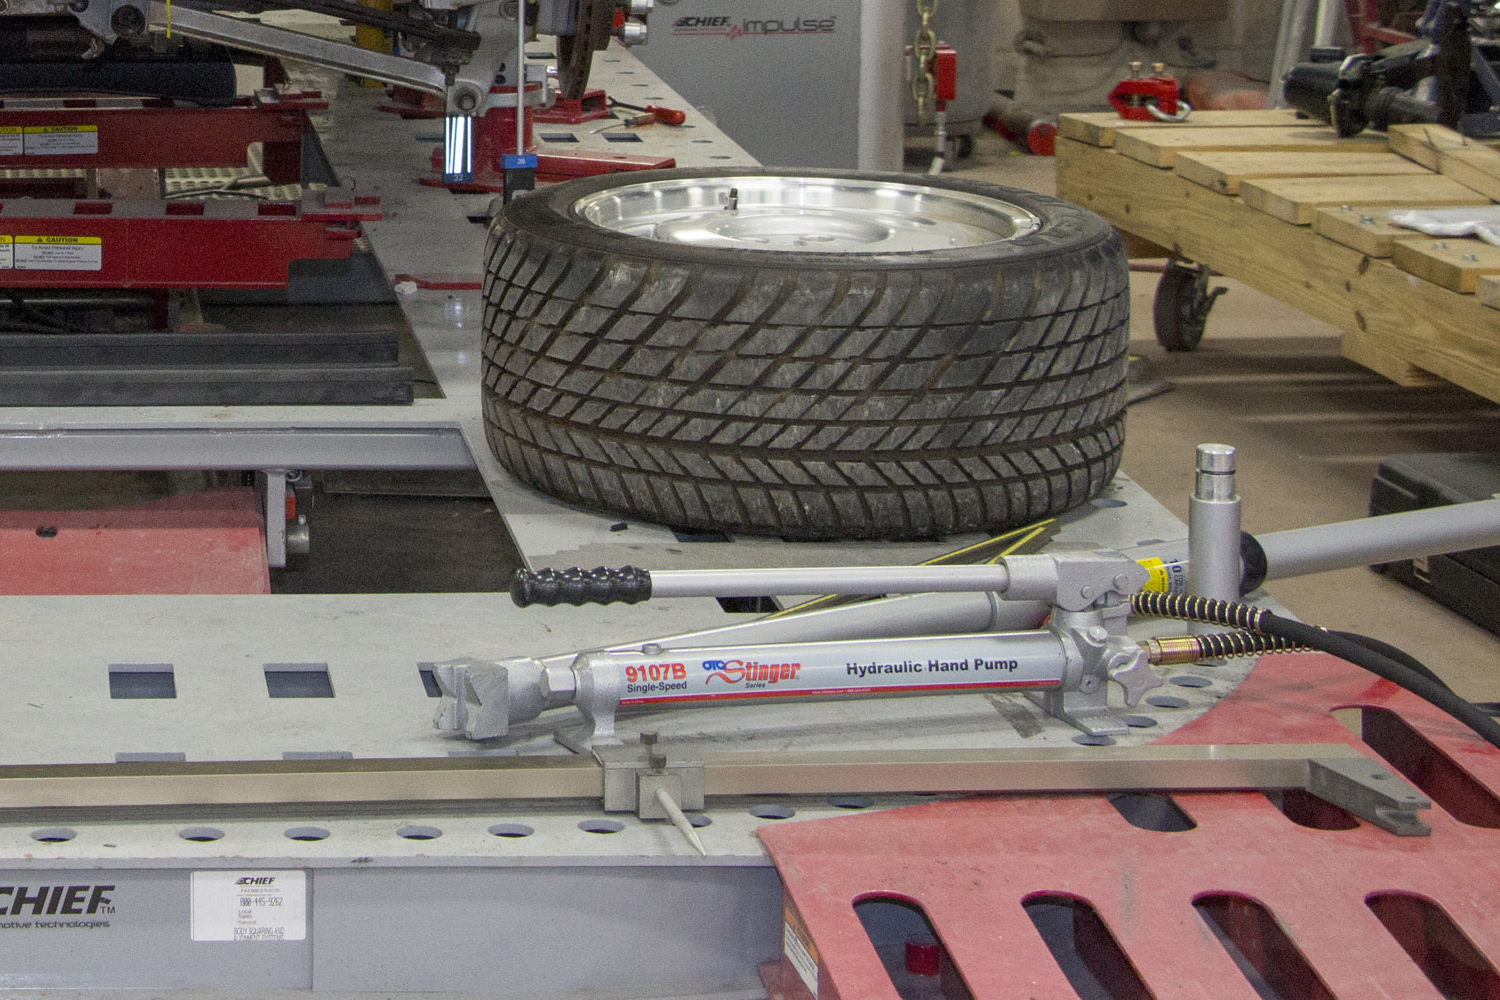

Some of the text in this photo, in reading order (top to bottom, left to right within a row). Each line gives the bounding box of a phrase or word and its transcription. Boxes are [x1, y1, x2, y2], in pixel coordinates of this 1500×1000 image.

[682, 16, 730, 27] CHIEF
[625, 662, 686, 683] 9107B
[705, 659, 801, 685] Stinger
[846, 657, 1018, 678] Hydraulic Hand Pump
[627, 681, 687, 693] Single-Speed
[243, 877, 275, 885] CHIEF
[35, 920, 110, 930] technologies
